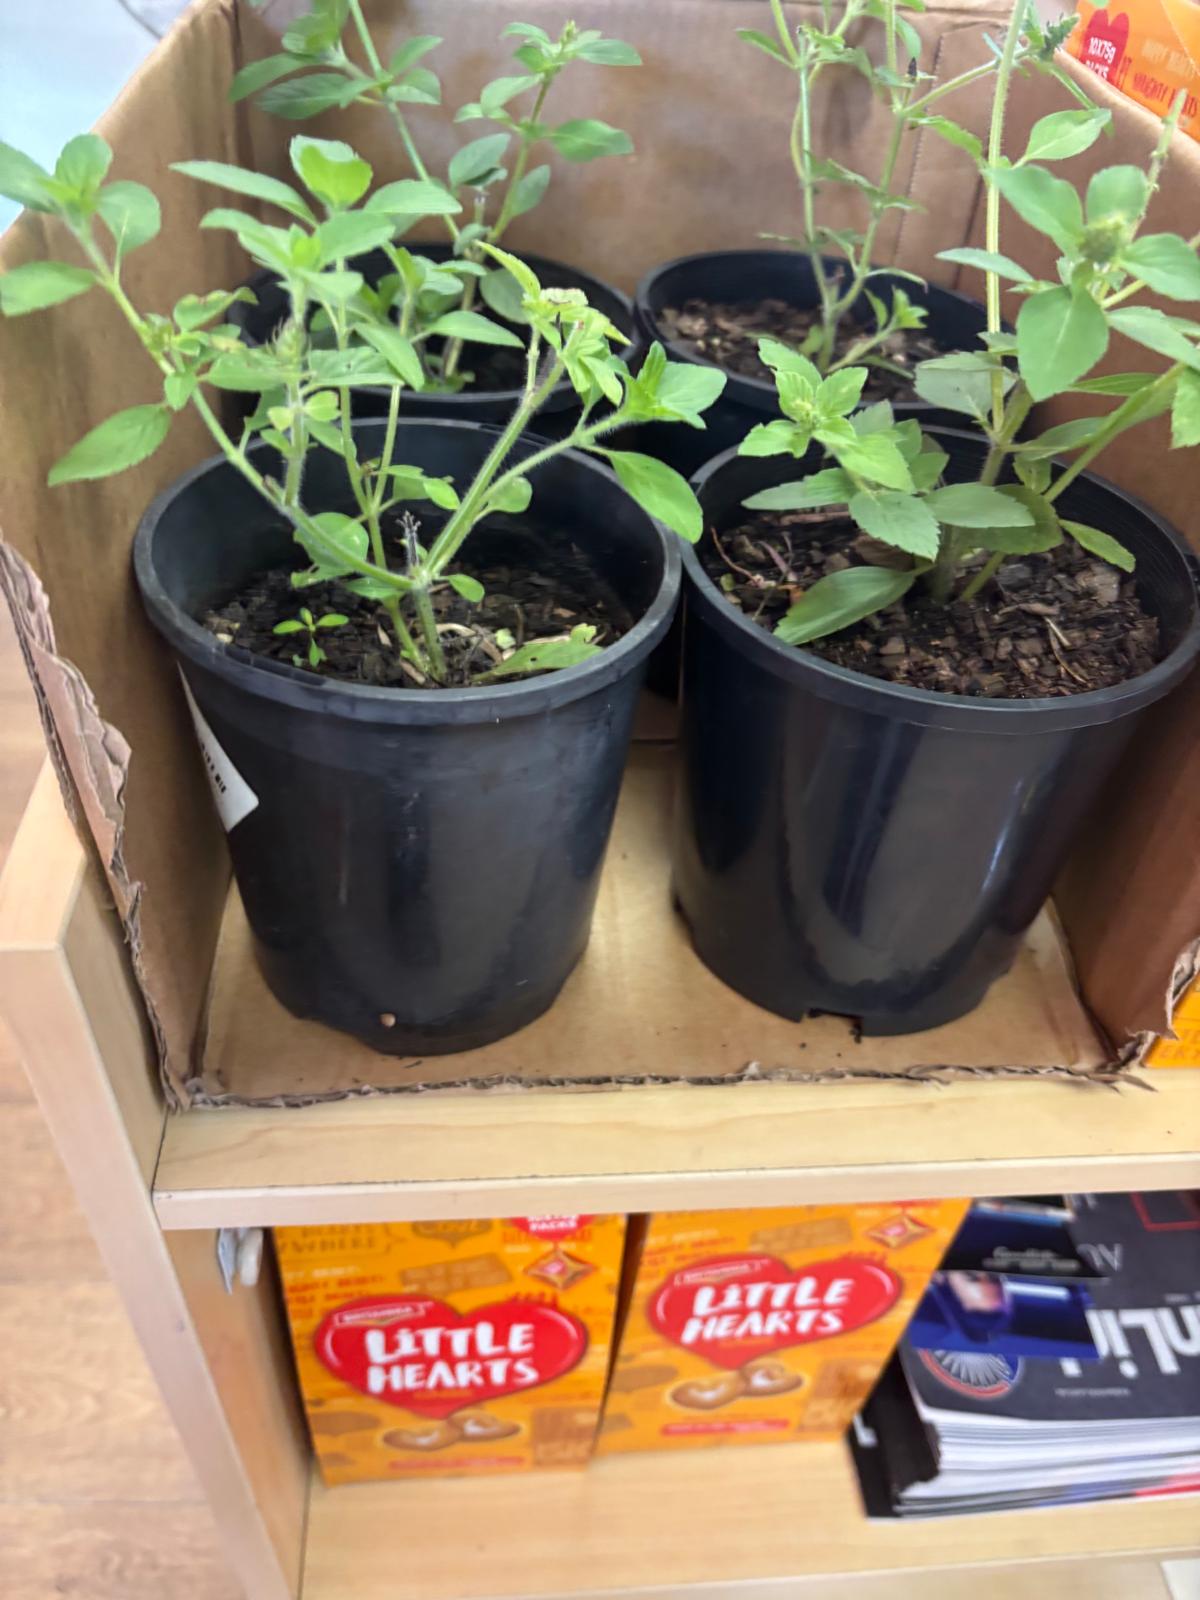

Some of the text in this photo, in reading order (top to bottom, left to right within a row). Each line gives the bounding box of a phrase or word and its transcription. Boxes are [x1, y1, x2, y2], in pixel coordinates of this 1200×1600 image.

[693, 1276, 854, 1316] LITTLE
[365, 1321, 535, 1364] LITTLE
[680, 1309, 844, 1344] HEARTS
[367, 1358, 539, 1394] HEARTS
